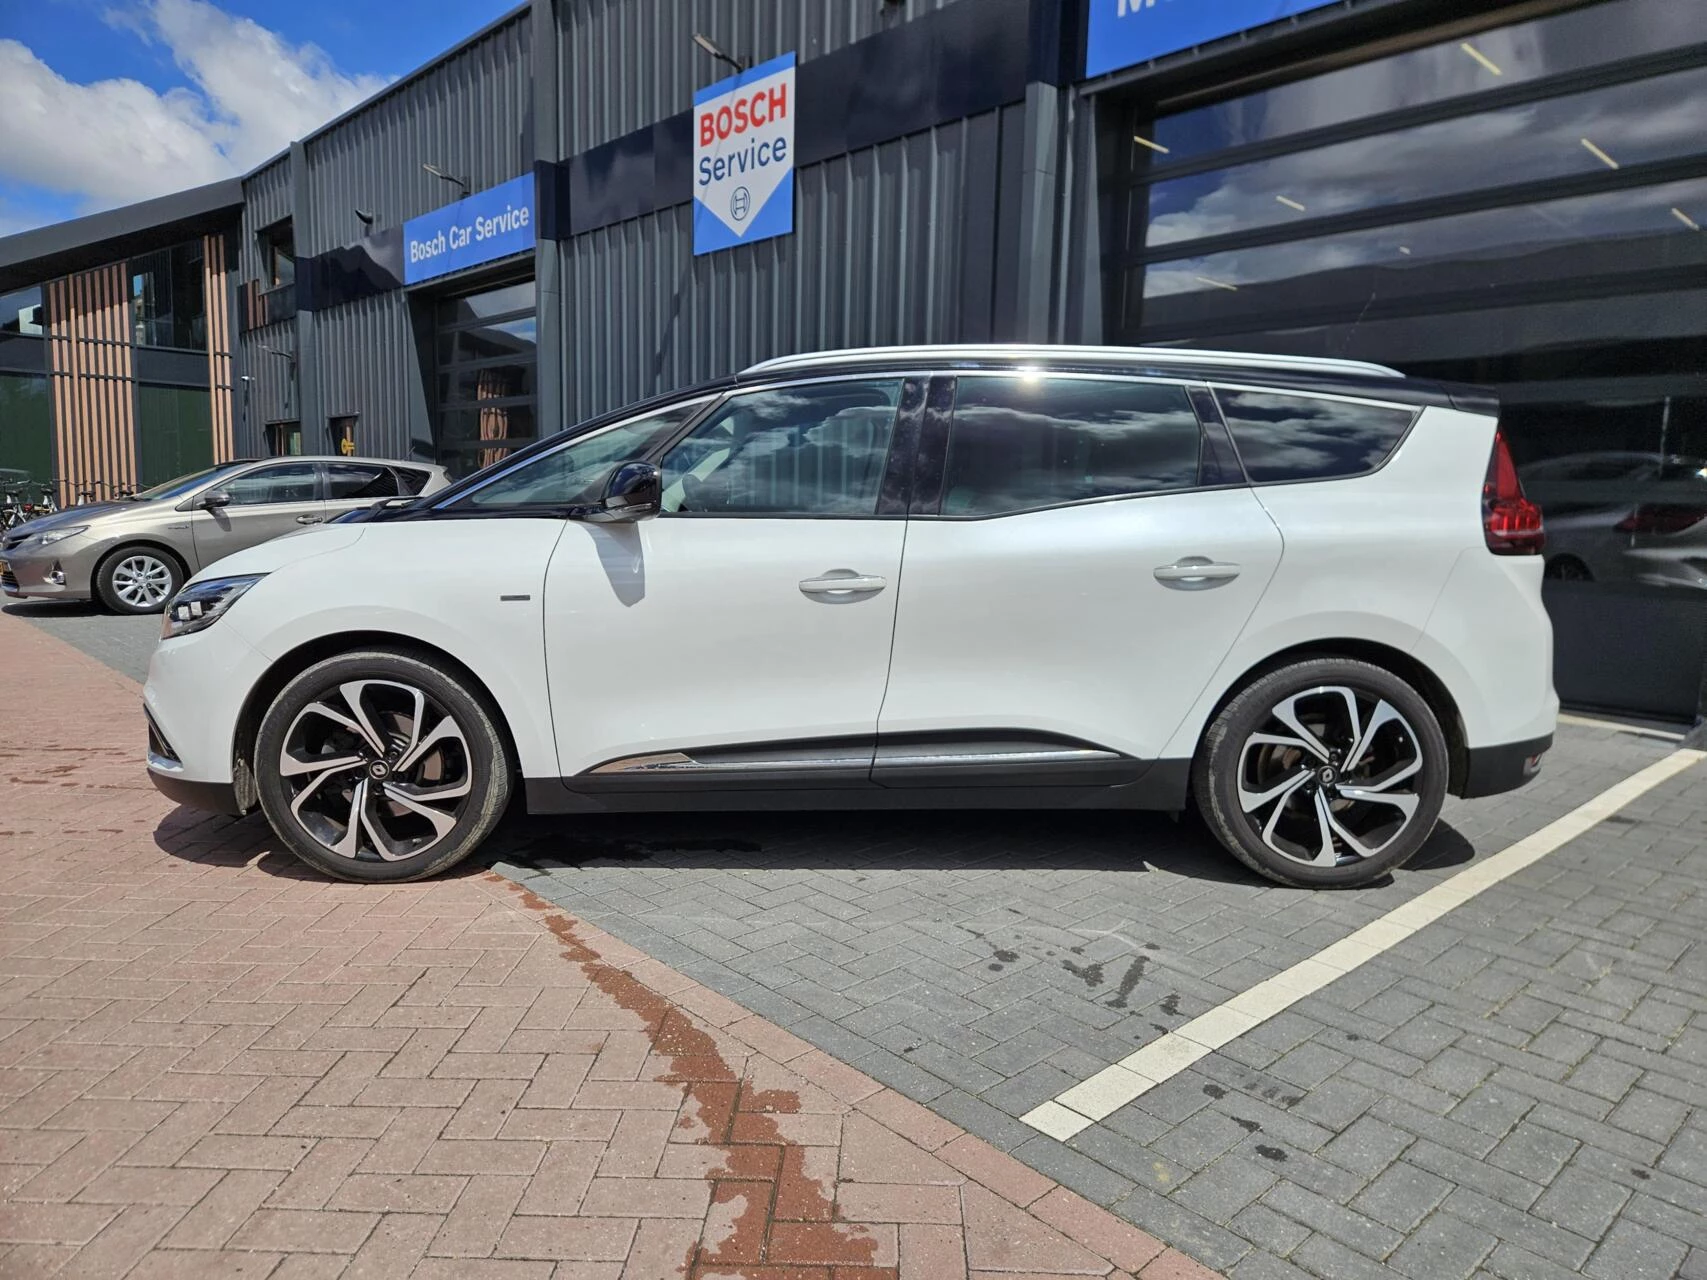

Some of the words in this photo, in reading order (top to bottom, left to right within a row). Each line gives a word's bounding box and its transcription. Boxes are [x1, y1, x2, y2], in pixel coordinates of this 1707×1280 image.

[700, 82, 787, 148] BOSCH
[698, 136, 787, 186] Service
[410, 230, 446, 263] Bosch
[449, 225, 473, 250] Car
[475, 204, 530, 241] Service
